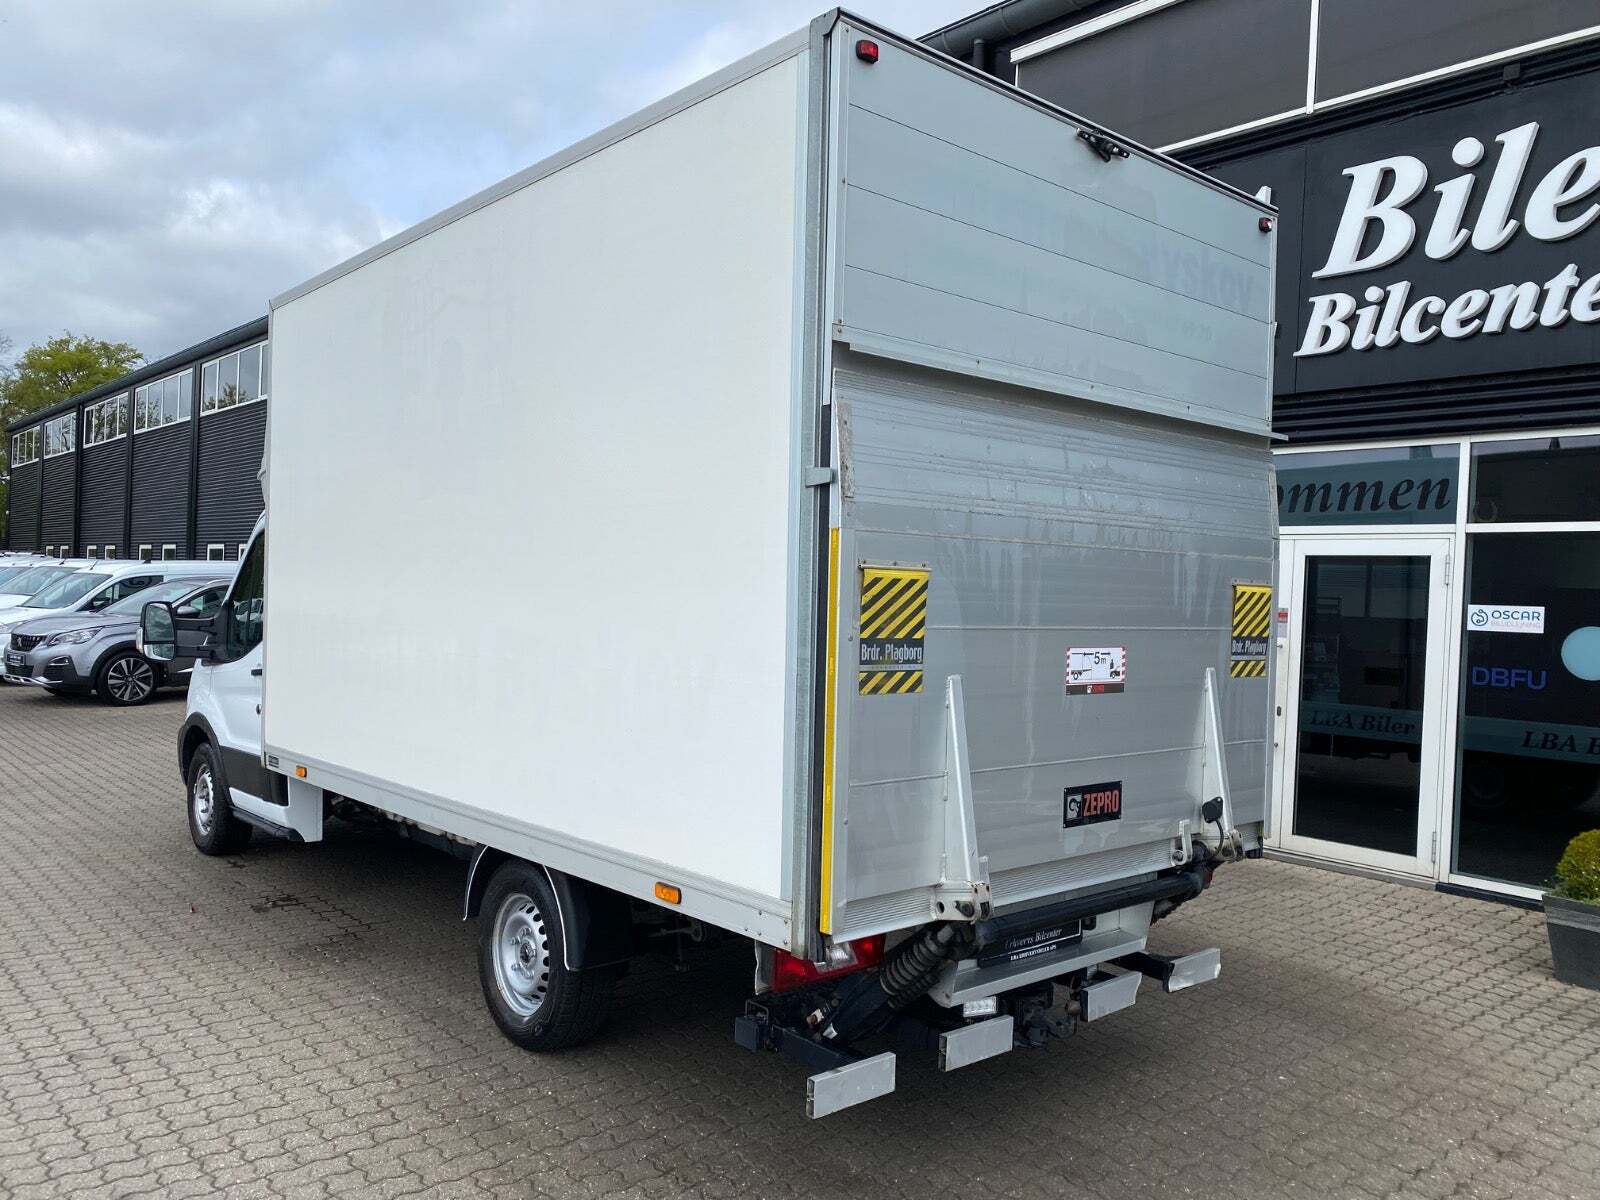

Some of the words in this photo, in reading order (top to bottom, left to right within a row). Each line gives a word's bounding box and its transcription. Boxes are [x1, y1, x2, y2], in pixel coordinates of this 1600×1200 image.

[1312, 121, 1600, 279] Bile
[1293, 263, 1600, 357] Bilcente
[1277, 478, 1451, 513] mmen
[1491, 610, 1541, 621] OSCAR
[861, 643, 883, 661] Brdr.
[885, 643, 923, 664] Plagborg
[1472, 666, 1547, 690] DBFU
[1310, 710, 1354, 729] LBA
[1360, 714, 1416, 734] Biler
[1521, 730, 1577, 753] LBA
[1083, 790, 1120, 817] ZEPRO
